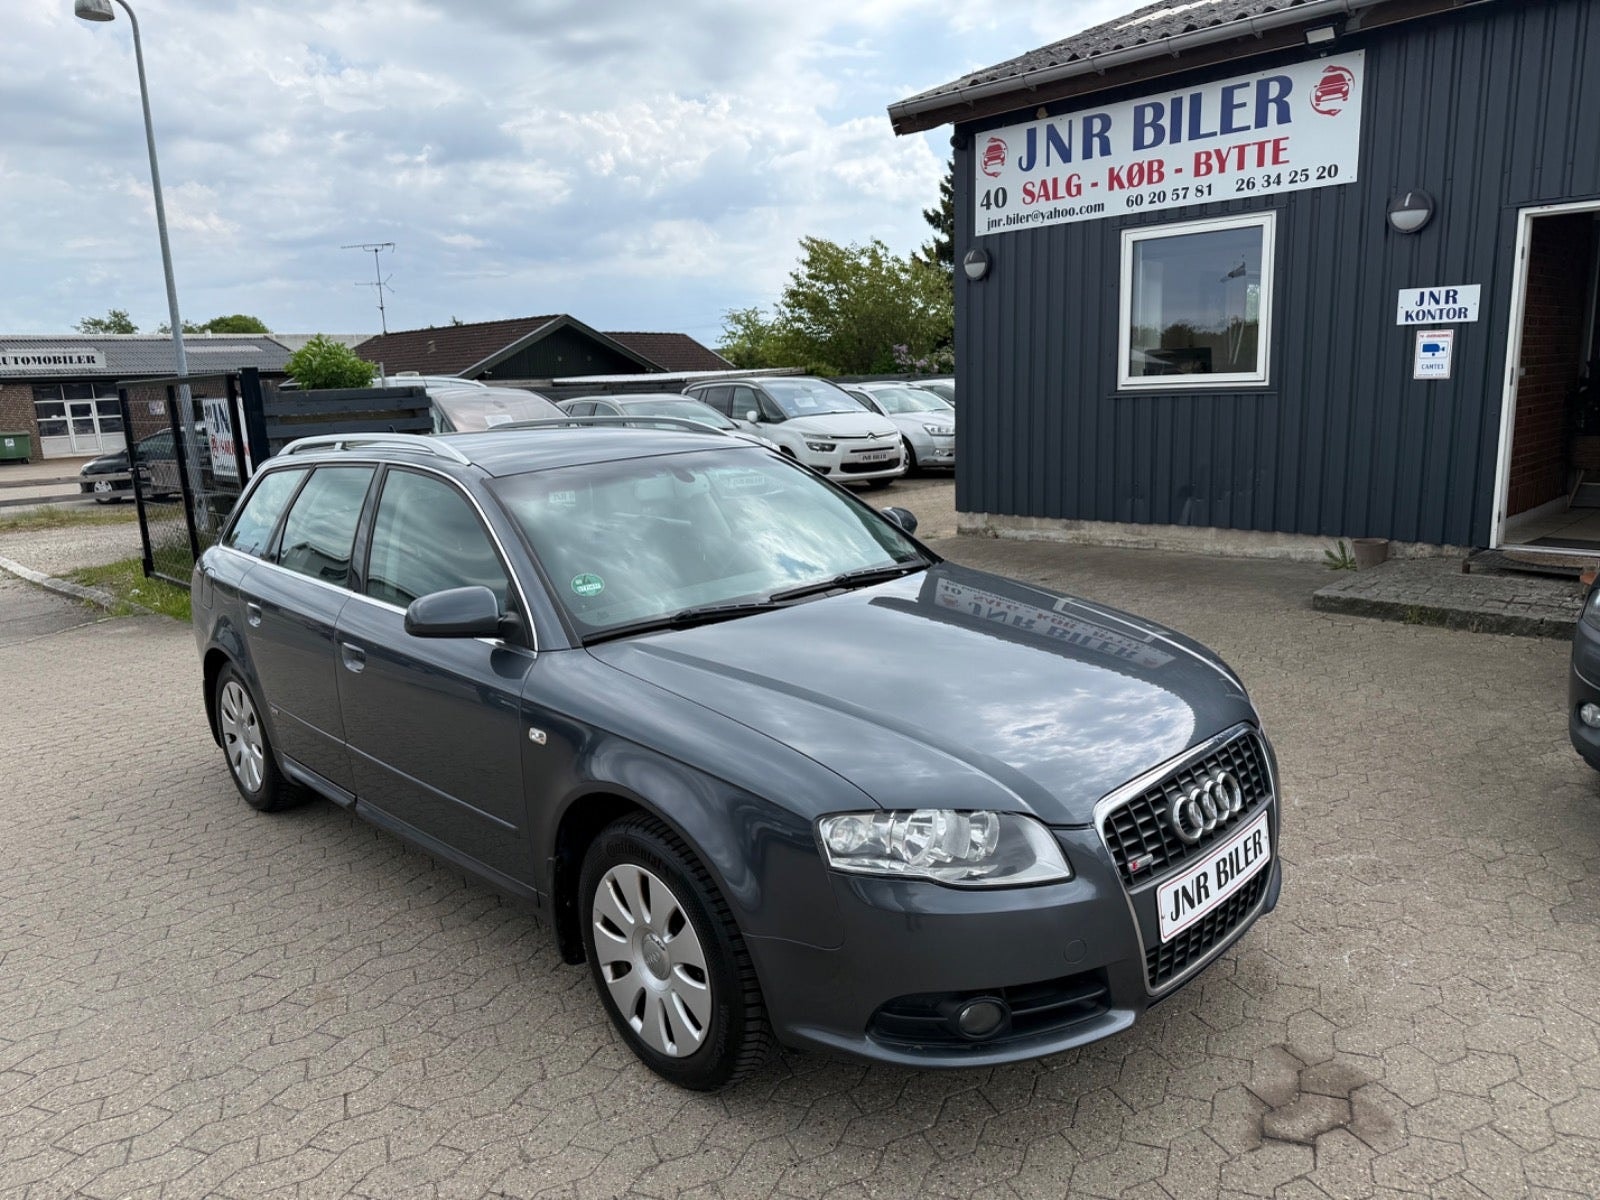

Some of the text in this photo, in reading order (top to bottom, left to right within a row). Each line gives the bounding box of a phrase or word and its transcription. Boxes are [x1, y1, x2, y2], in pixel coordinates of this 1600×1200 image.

[1018, 75, 1293, 172] JNR BILER
[1022, 173, 1082, 205] SALG
[1108, 158, 1165, 192] KØB
[1193, 136, 1290, 178] BYTTE
[1125, 164, 1339, 208] 60 20 57 81 26 34 25 20
[980, 186, 1008, 211] 40
[987, 202, 1105, 231] jnr.biler@yahoo.com
[1415, 289, 1458, 306] JNR
[1404, 307, 1469, 322] KONTOR
[212, 403, 232, 434] JN
[1170, 828, 1263, 922] JNR BILER
